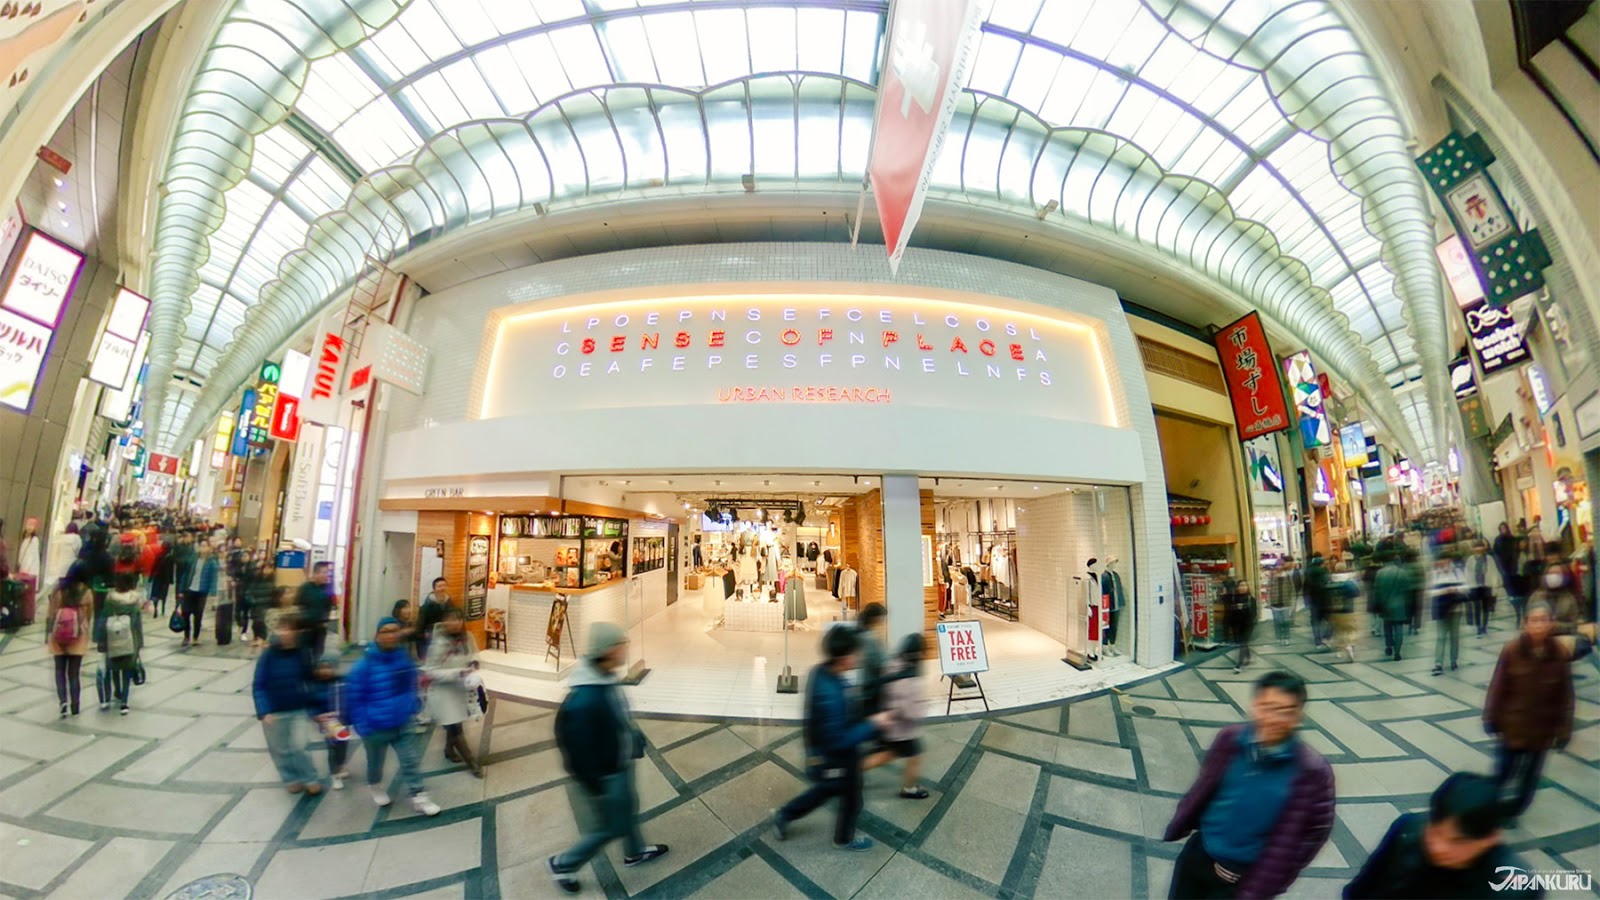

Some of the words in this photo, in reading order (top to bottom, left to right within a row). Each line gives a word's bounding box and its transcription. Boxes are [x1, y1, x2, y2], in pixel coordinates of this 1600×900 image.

[24, 257, 69, 285] DAISO
[19, 274, 60, 297] ダイソー
[580, 328, 726, 355] SENSE
[780, 327, 833, 346] OF
[882, 329, 1025, 361] PLACE
[311, 332, 346, 400] KAIUL
[1228, 325, 1268, 416] 市場ずし
[717, 386, 785, 402] URBAN
[792, 386, 891, 403] RESEARCH
[292, 462, 312, 522] SoftBank
[424, 488, 448, 498] GREEN
[450, 488, 464, 497] BAR
[948, 629, 975, 646] TAX
[950, 645, 977, 662] FREE
